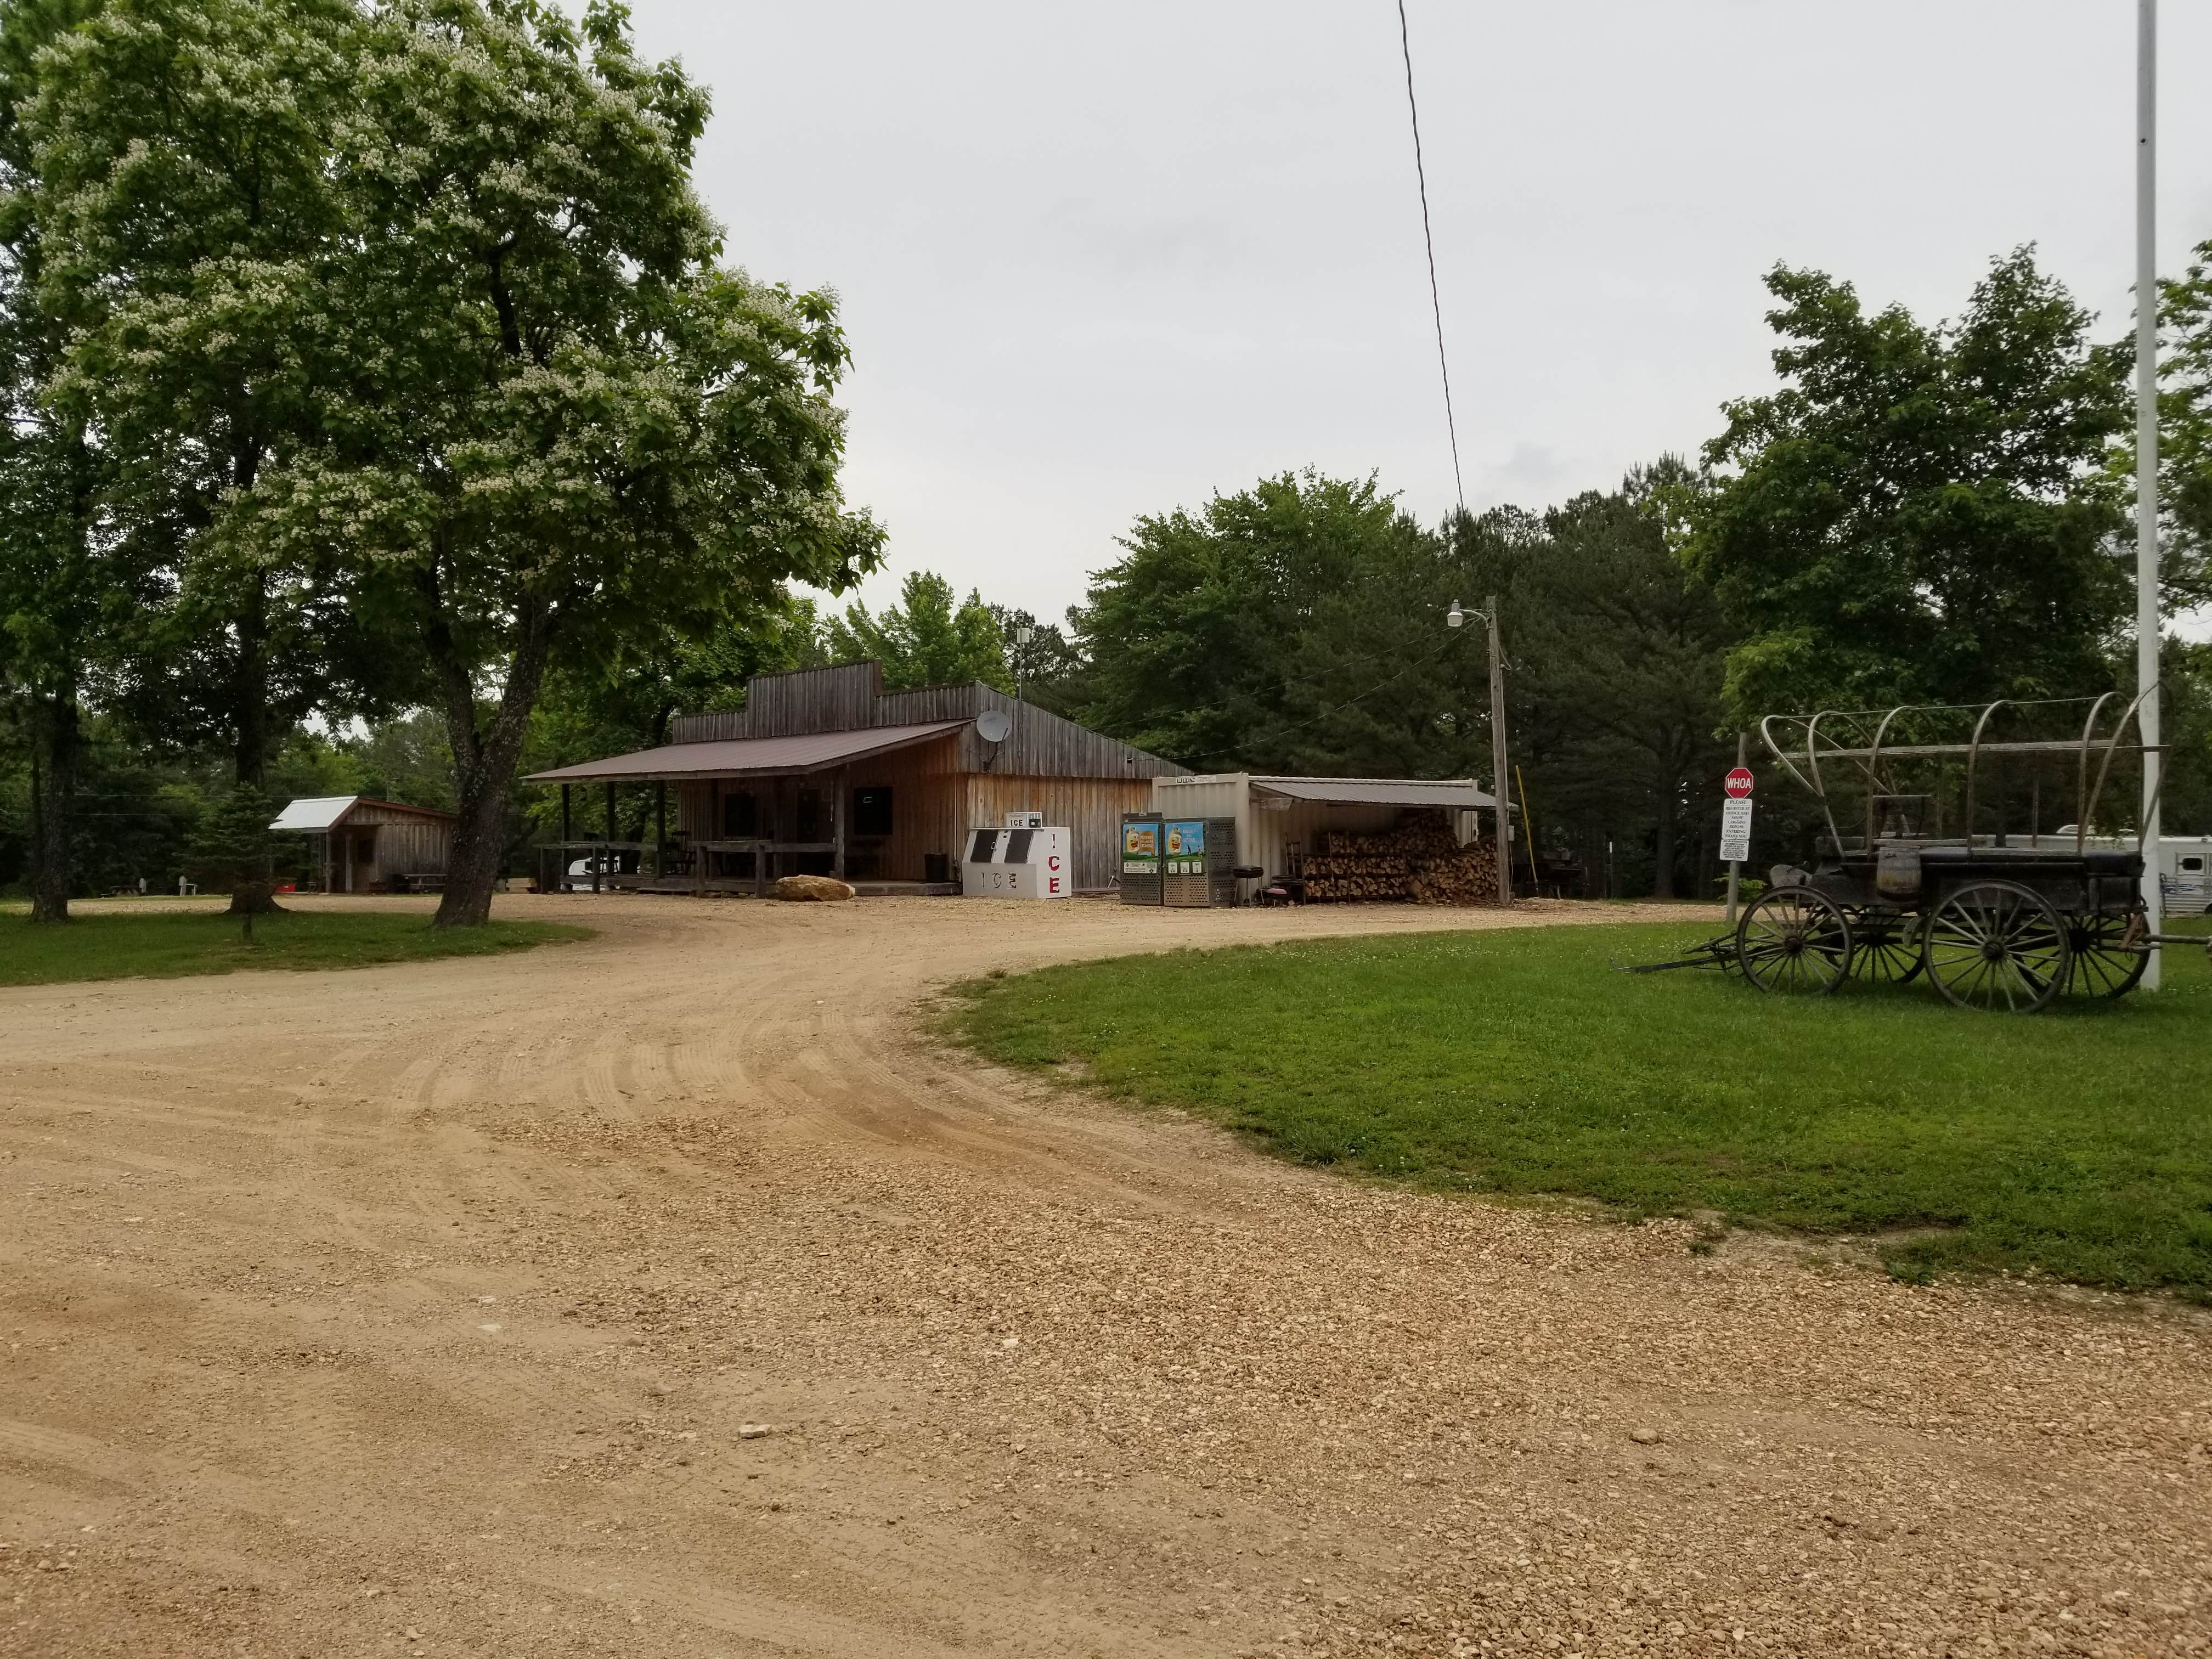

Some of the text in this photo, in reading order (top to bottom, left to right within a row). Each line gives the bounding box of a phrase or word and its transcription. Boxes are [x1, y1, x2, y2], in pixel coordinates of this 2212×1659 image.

[1727, 777, 1752, 789] WHOA
[1048, 833, 1060, 893] ICE
[981, 872, 1017, 889] ICE
